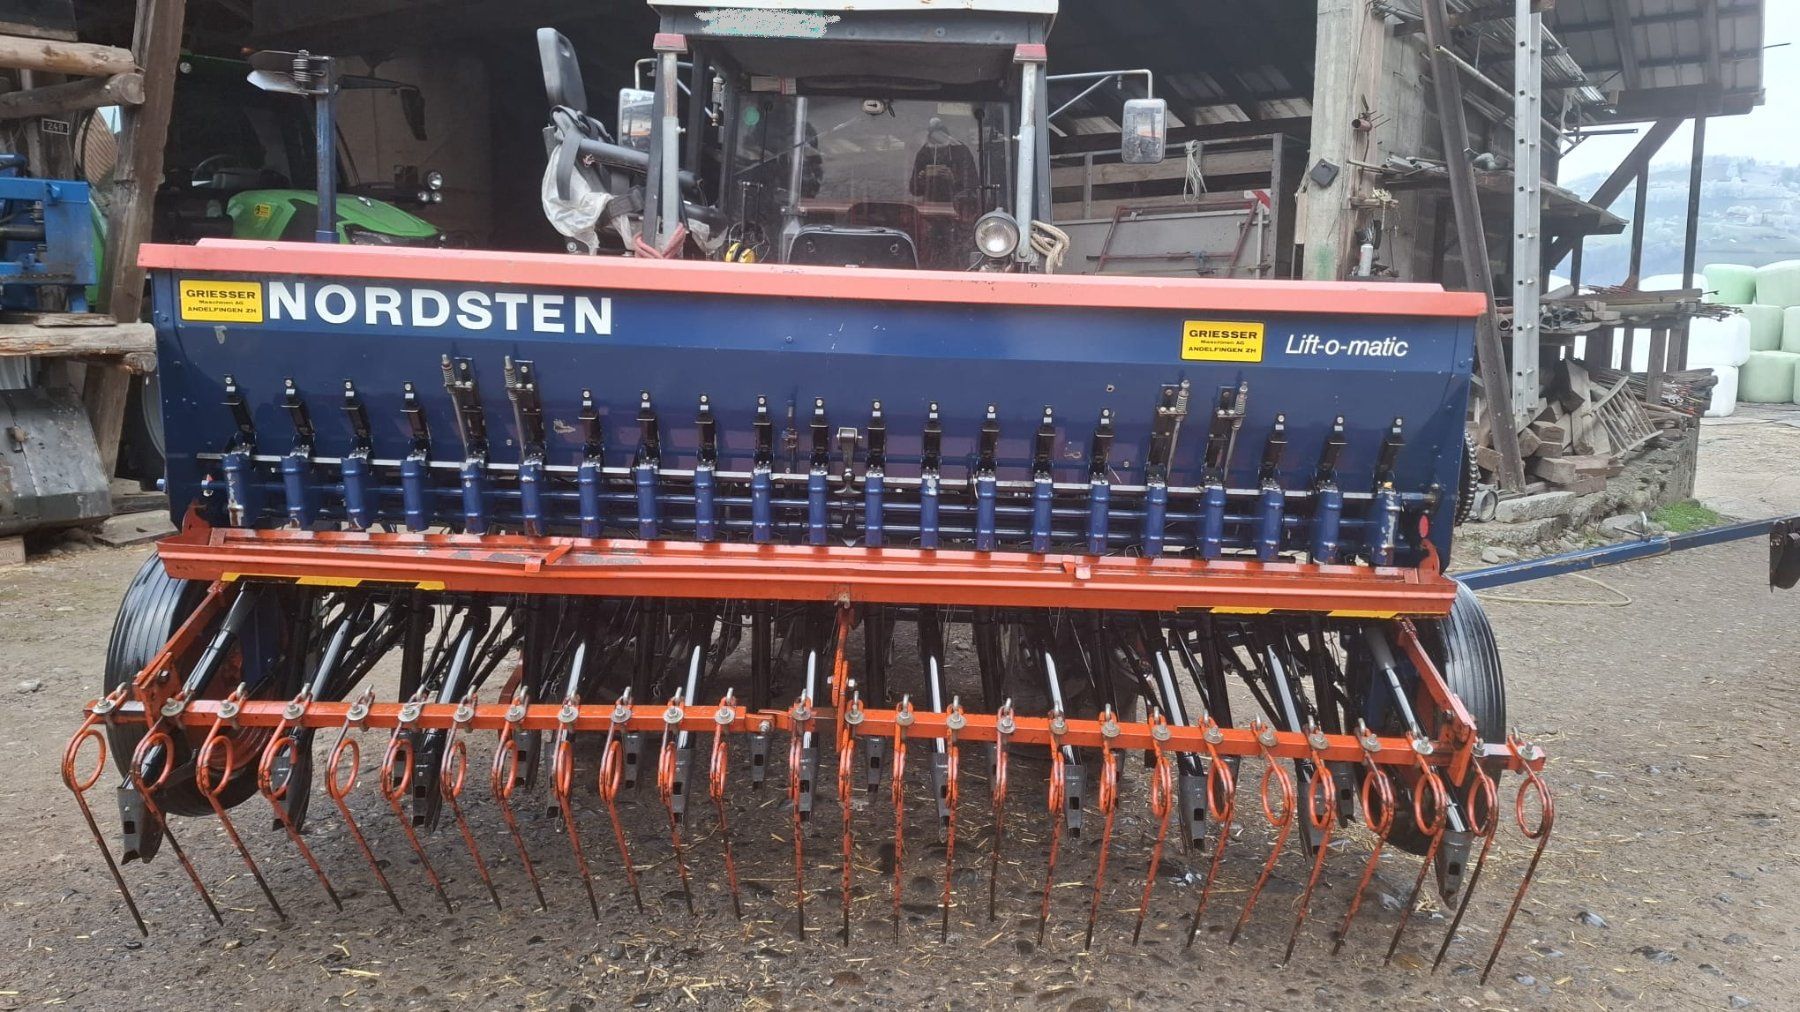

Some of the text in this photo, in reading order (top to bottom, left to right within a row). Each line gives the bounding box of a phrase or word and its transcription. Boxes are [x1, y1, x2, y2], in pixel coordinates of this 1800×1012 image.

[186, 289, 256, 299] GRIESSER
[268, 281, 612, 335] NORDSTEN
[1189, 329, 1258, 339] GRIESSER
[1285, 334, 1409, 357] Lift-o-matic
